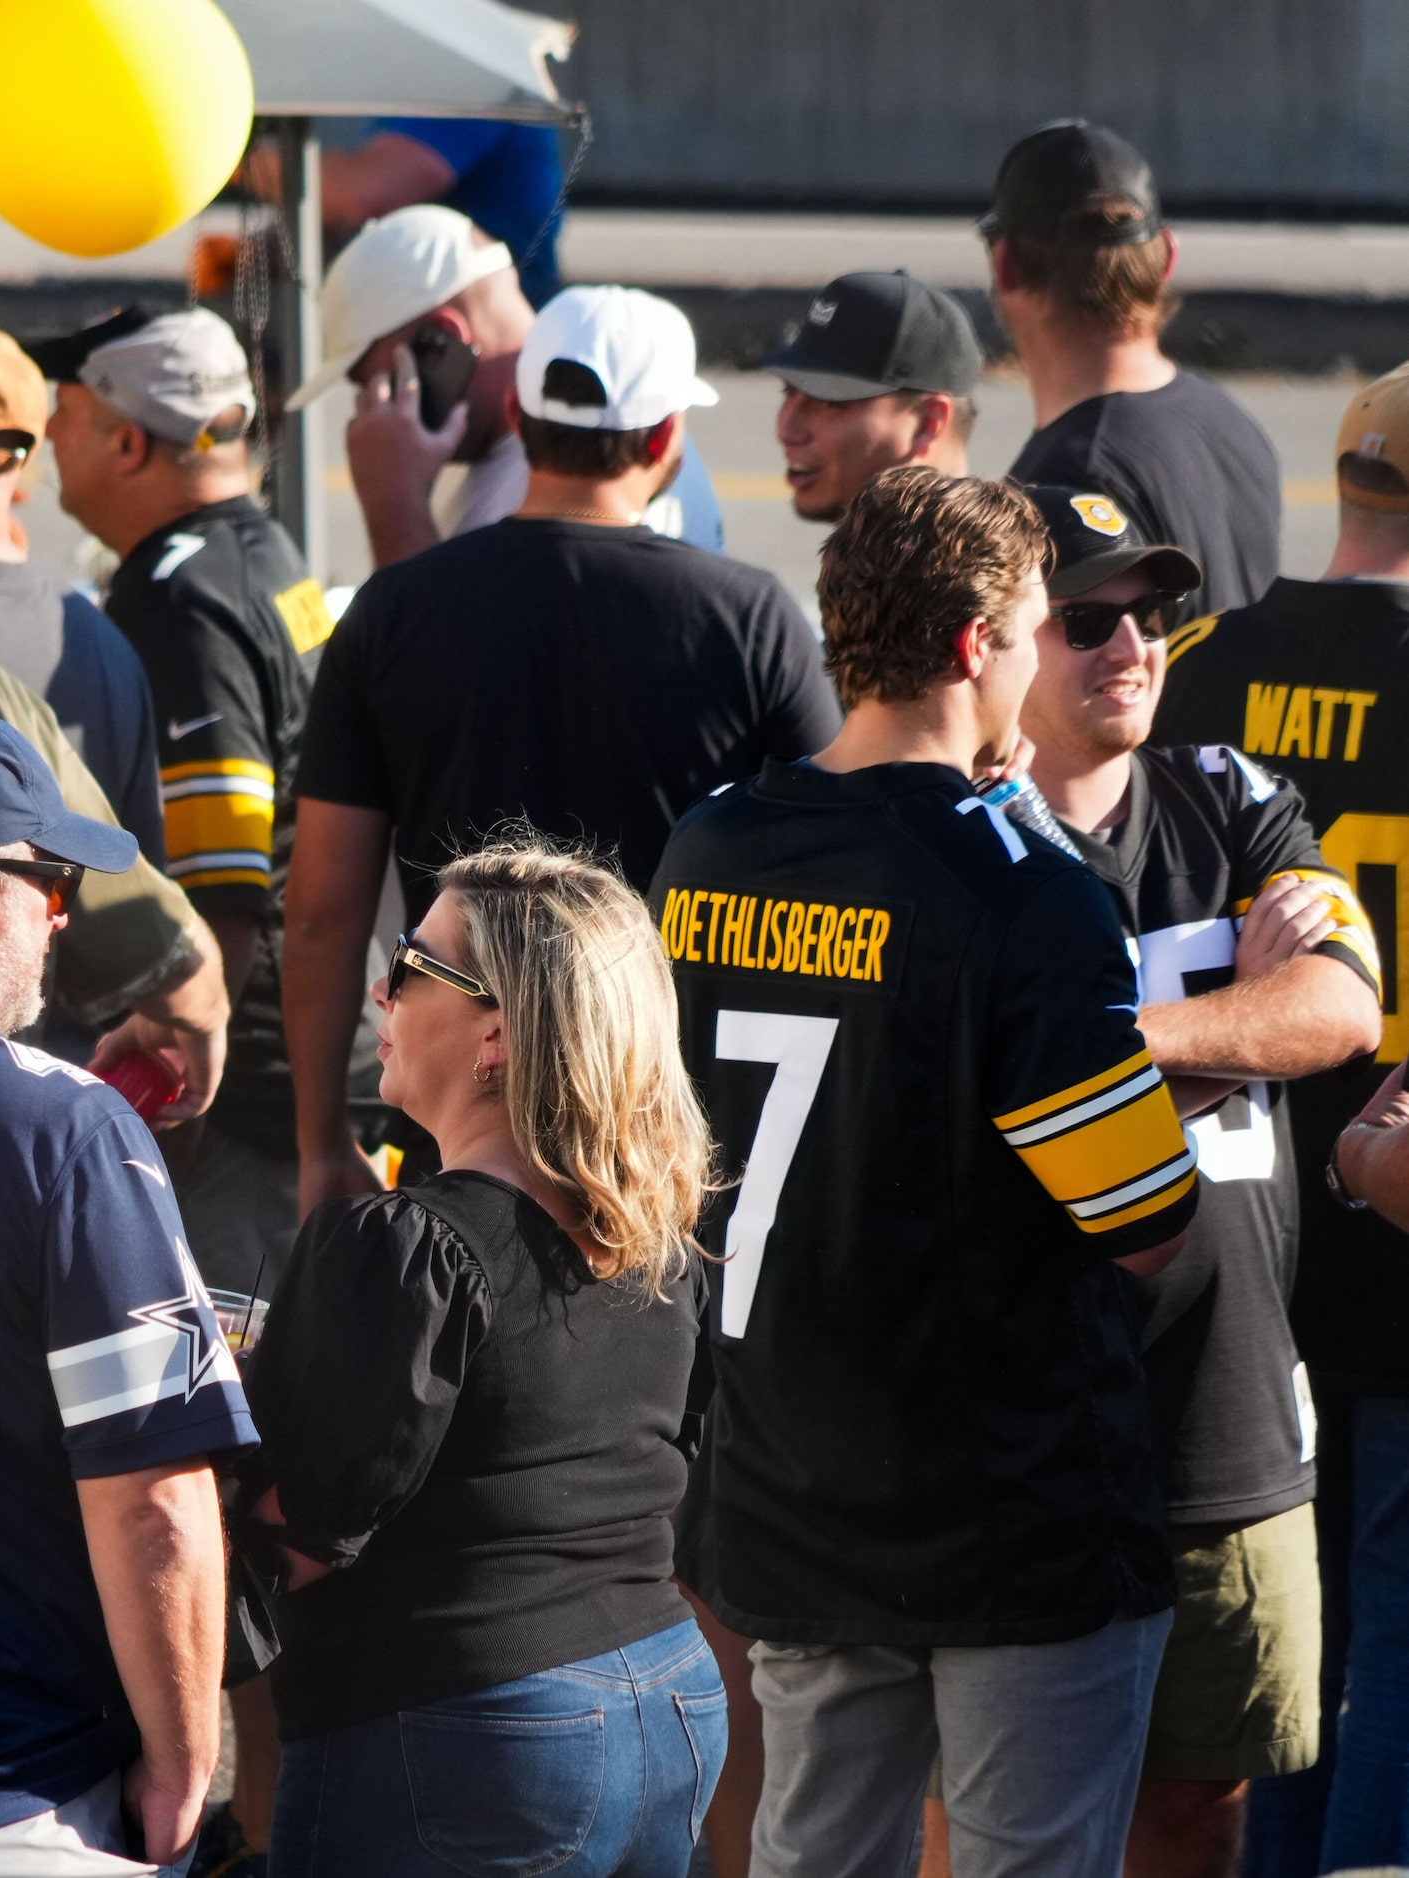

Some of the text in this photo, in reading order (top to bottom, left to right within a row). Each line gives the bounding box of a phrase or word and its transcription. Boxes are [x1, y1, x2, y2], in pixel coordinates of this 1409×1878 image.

[151, 533, 207, 581] 7
[1244, 681, 1378, 762] WATT
[955, 797, 1029, 864] 7
[715, 1009, 840, 1340] 7
